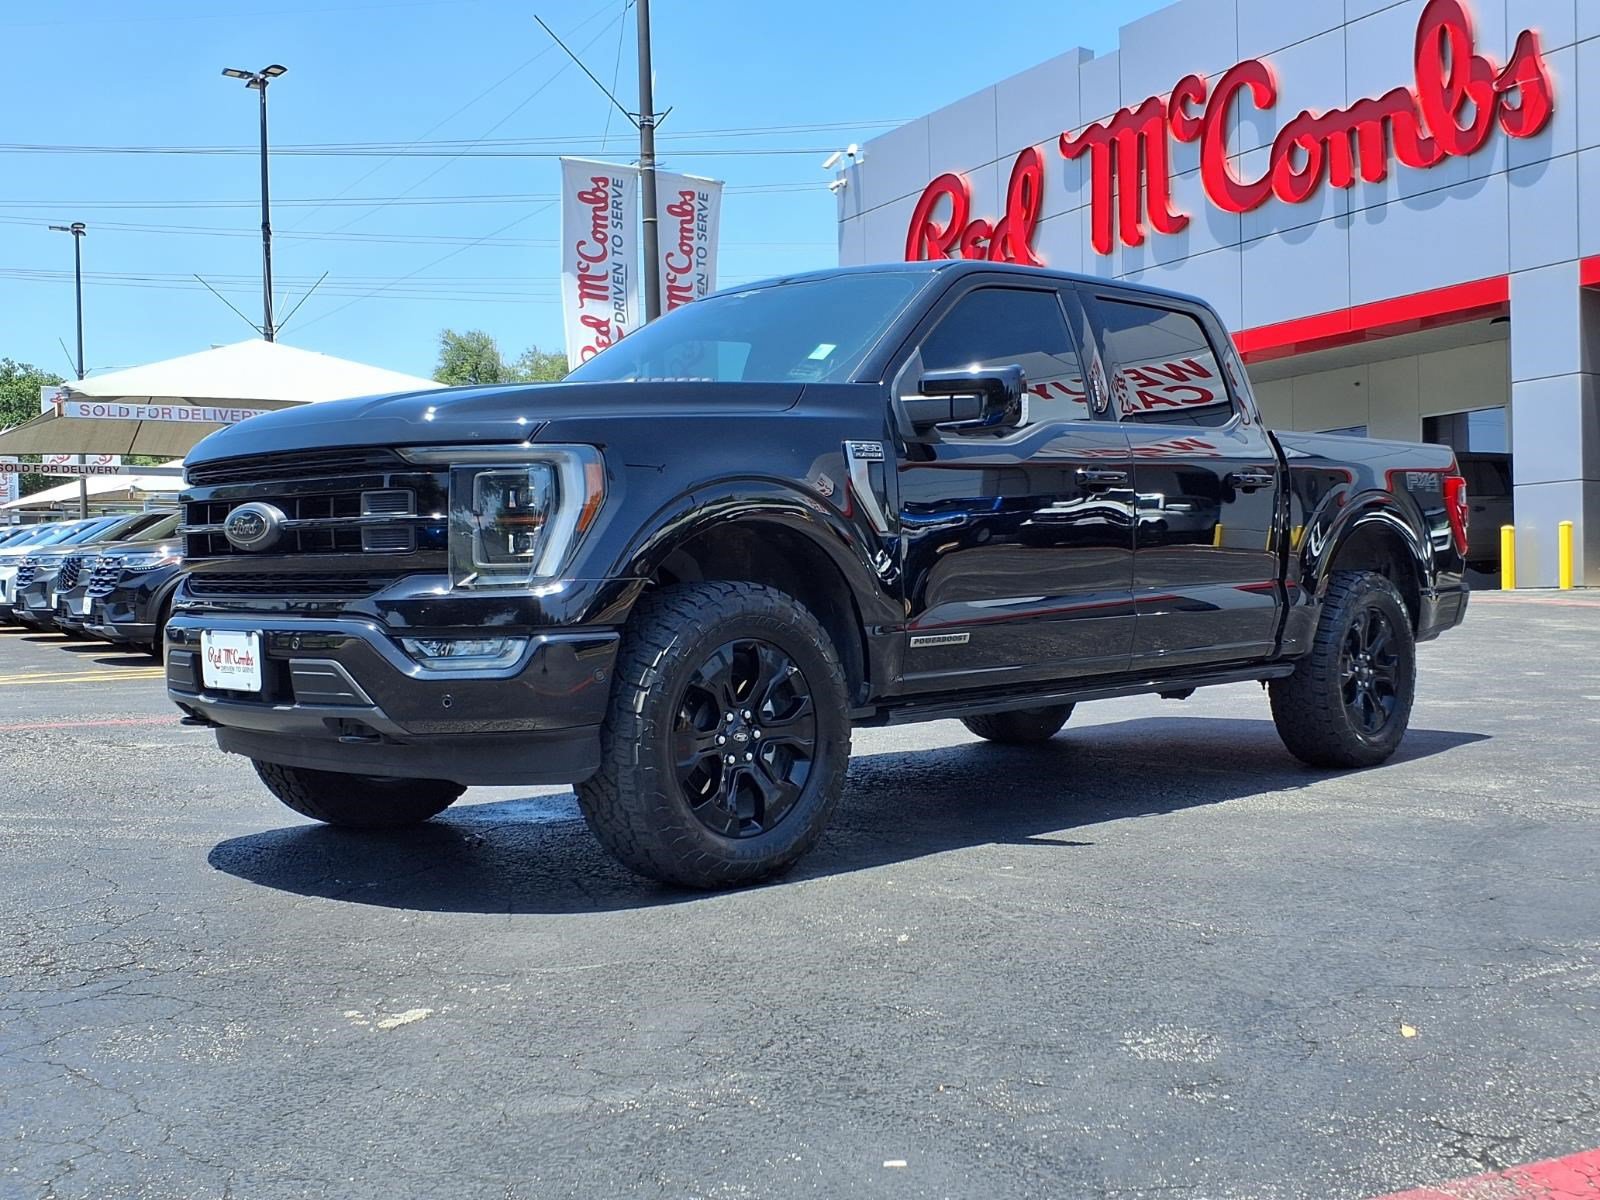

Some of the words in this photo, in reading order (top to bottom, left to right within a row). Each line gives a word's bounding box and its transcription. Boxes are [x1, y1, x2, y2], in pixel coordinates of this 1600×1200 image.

[904, 147, 1044, 267] Red
[1060, 0, 1553, 255] McCombs
[612, 177, 624, 230] SERVE
[697, 191, 709, 242] SERVE
[576, 175, 609, 308] McCombs
[611, 235, 624, 257] TO
[696, 246, 708, 269] TO
[612, 262, 627, 324] DRIVEN
[80, 404, 129, 418] SOLD
[136, 406, 172, 419] FOR
[34, 464, 58, 474] FOR
[62, 465, 120, 475] DELIVERY
[231, 514, 258, 535] Ford
[913, 634, 969, 645] POWERBOOST
[207, 646, 222, 669] Red
[222, 648, 254, 667] McCombs
